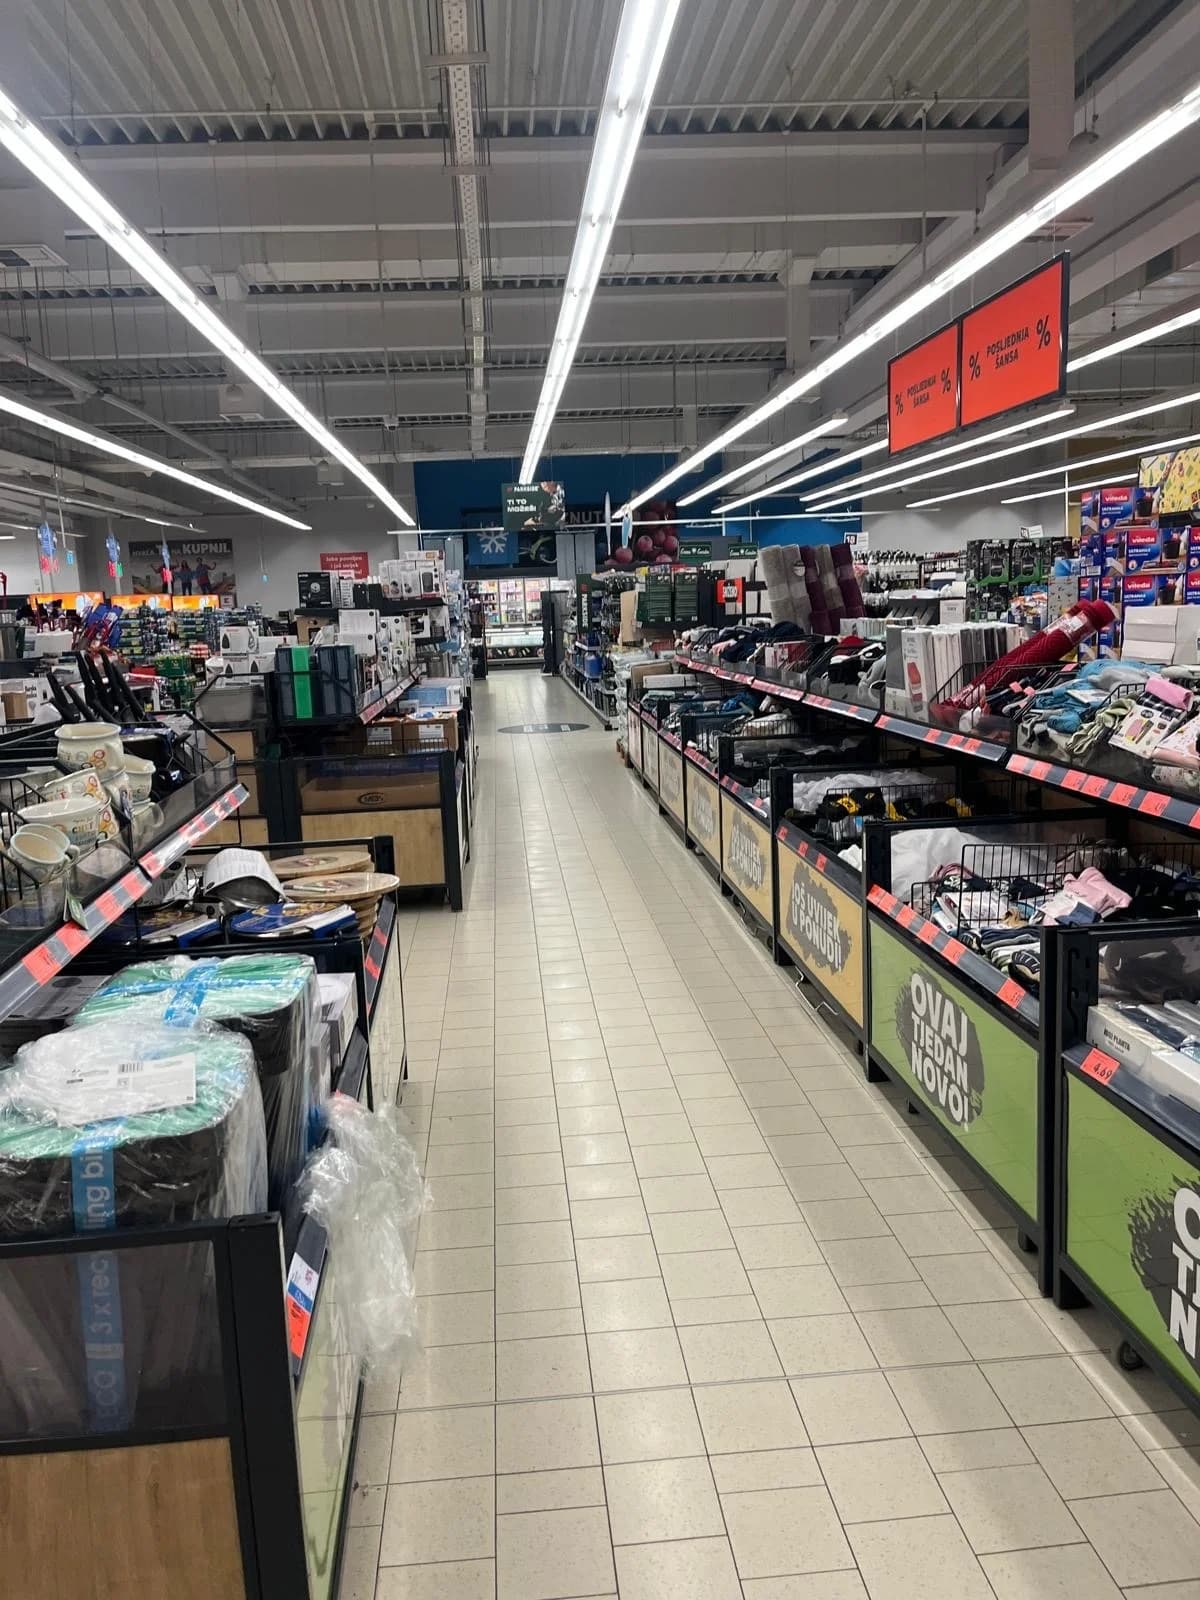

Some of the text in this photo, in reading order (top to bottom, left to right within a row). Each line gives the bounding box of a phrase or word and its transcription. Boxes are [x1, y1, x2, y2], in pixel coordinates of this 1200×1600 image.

[986, 326, 1030, 358] POSLJEDNJA
[994, 347, 1019, 370] ŠANSA
[792, 900, 842, 973] U PONUDI!
[807, 893, 841, 944] UVIJEK
[911, 972, 968, 1057] OVAJ
[911, 1010, 968, 1093] TJEDAN
[911, 1040, 969, 1133] NOVO!
